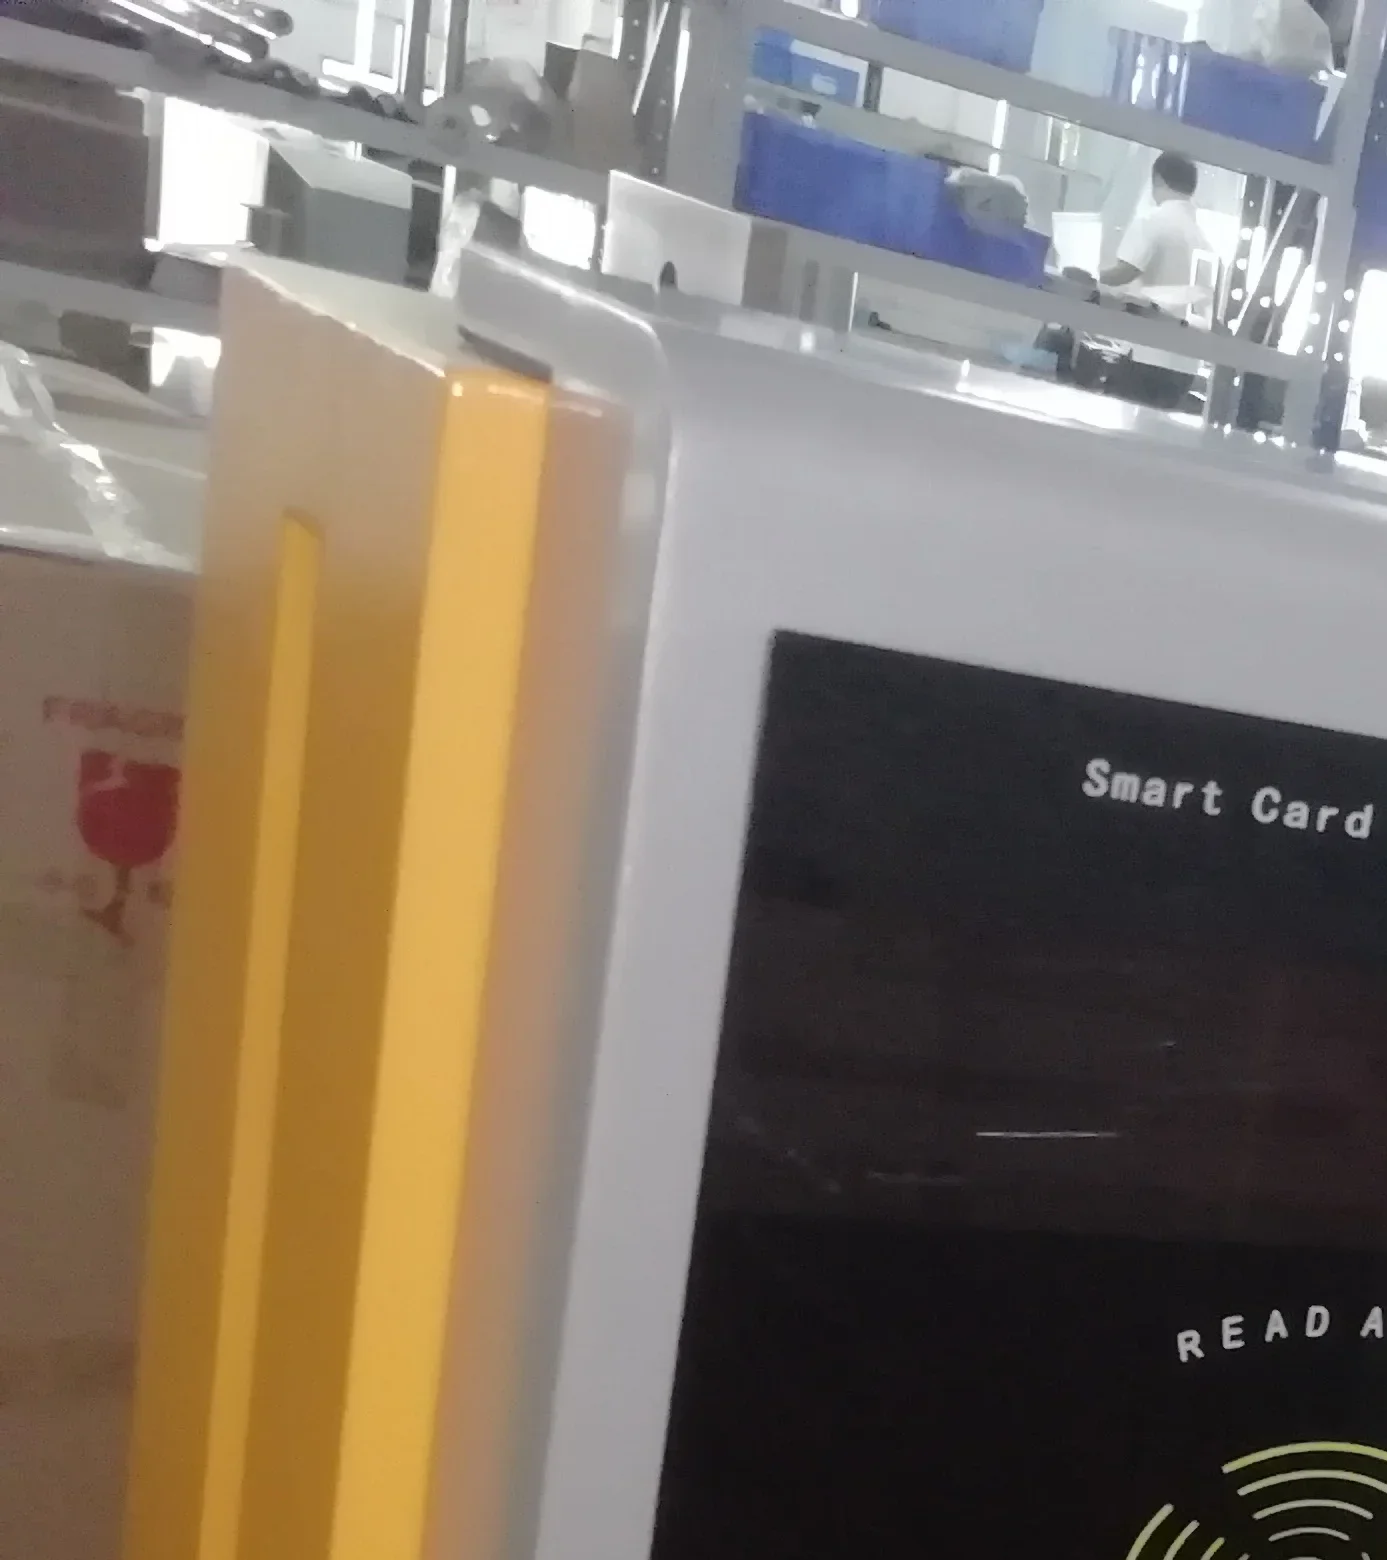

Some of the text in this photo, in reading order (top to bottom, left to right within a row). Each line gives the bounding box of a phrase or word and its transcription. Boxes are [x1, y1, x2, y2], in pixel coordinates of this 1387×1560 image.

[1081, 757, 1223, 816] Smart
[1251, 785, 1374, 840] Card
[1176, 1304, 1330, 1363] READ
